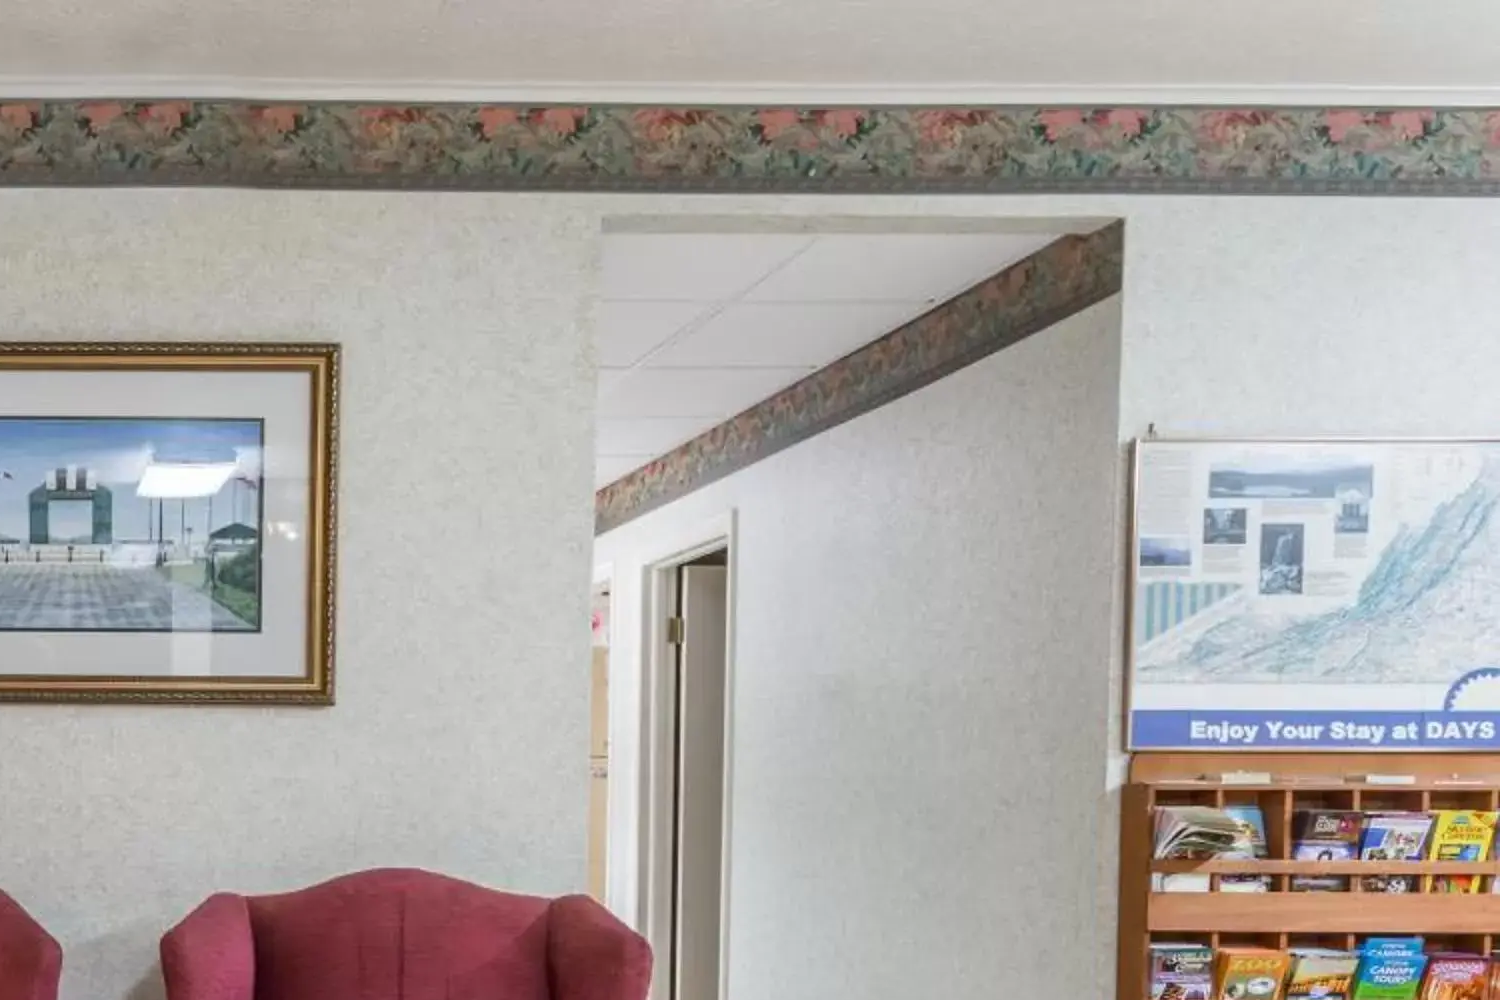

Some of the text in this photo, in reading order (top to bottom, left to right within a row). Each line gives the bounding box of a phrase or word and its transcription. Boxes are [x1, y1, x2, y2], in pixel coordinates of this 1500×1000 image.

[1190, 720, 1496, 744] Enjoy Your Stay at DAYS
